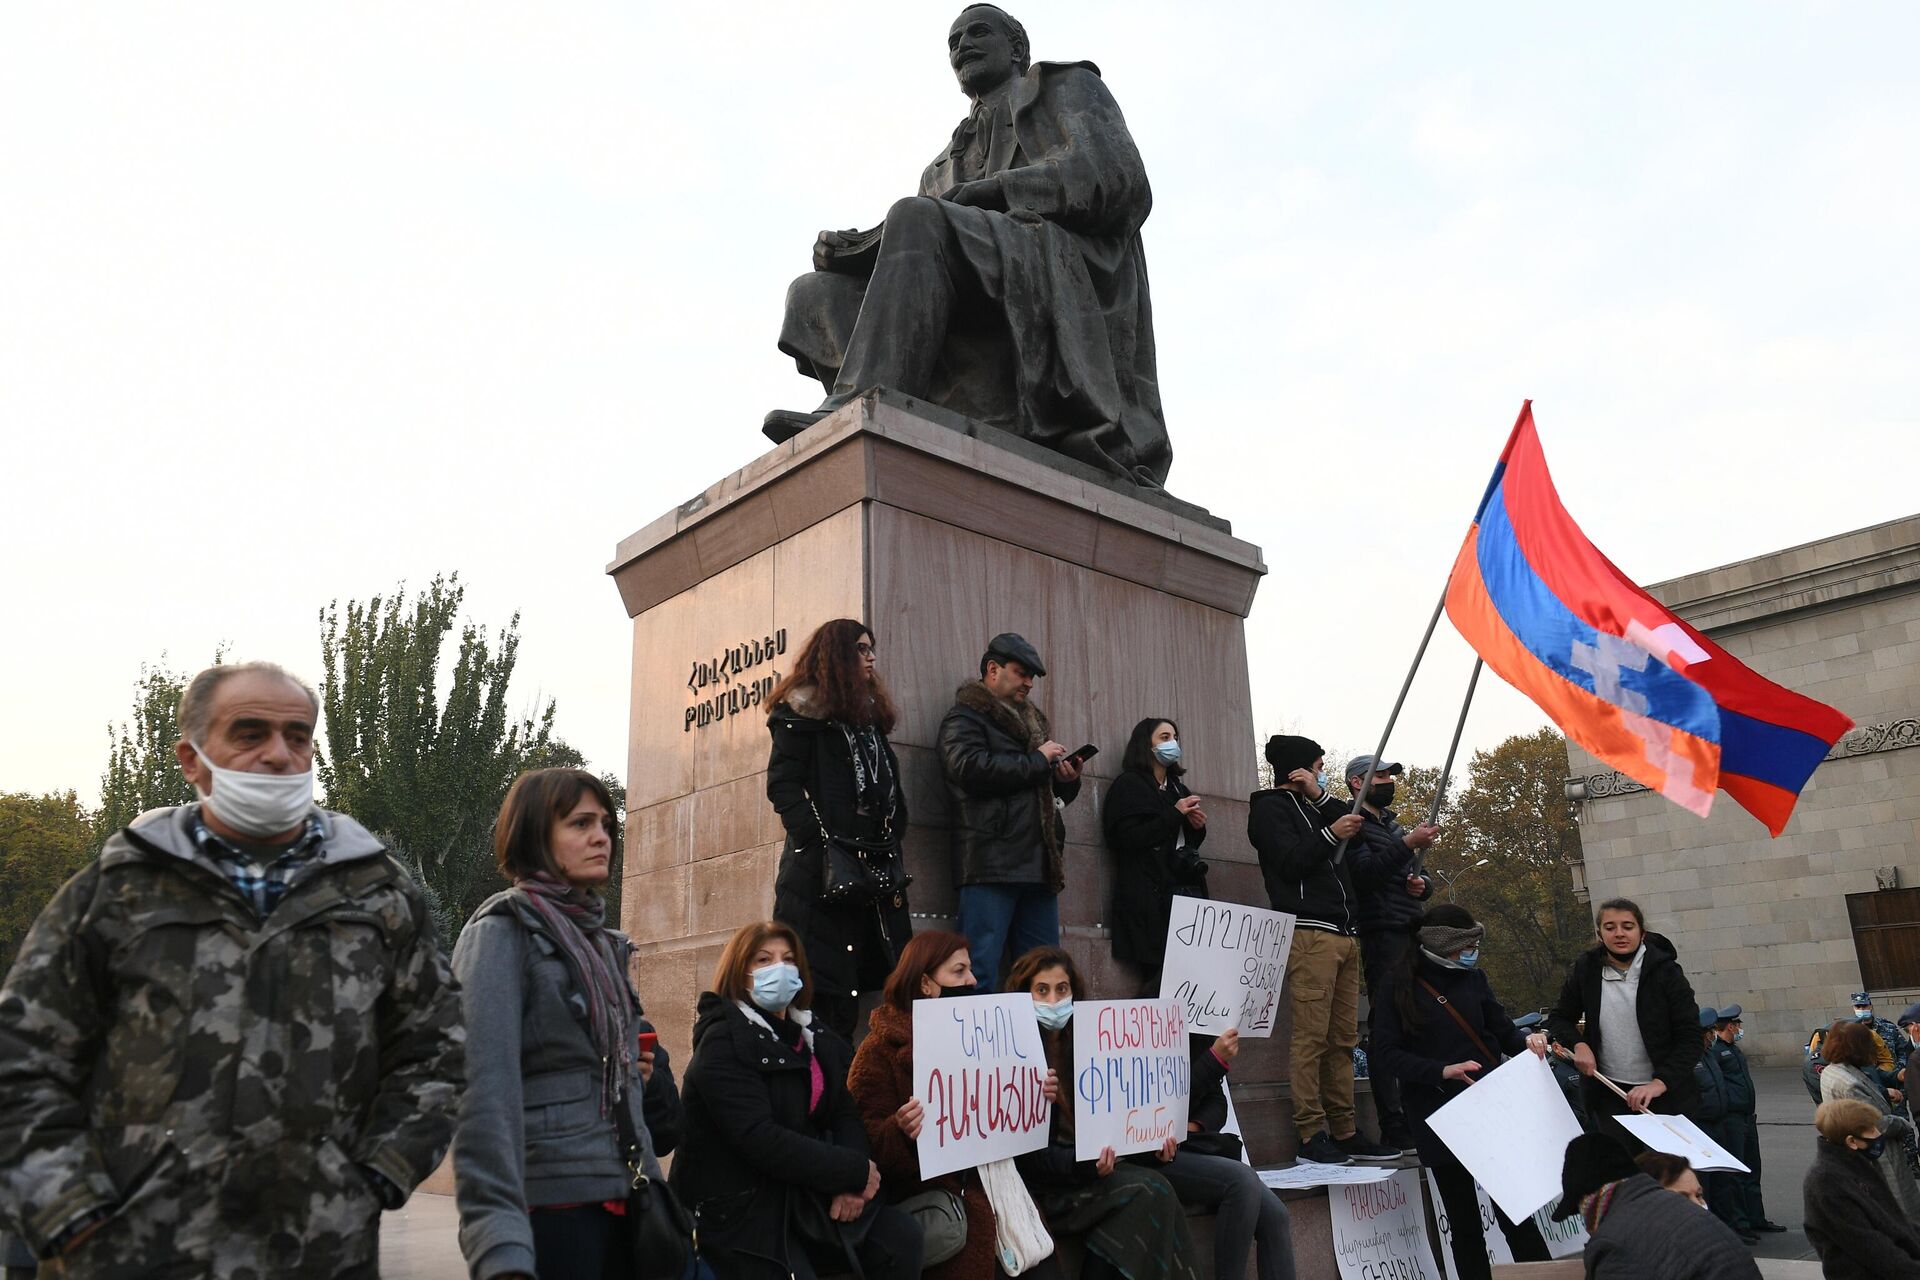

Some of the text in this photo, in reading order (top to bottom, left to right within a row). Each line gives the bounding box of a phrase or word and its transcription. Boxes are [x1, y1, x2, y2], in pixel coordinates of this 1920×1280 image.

[687, 628, 787, 697] ՀՈՎՀԱՆՆԵՍ
[1175, 904, 1288, 960] ԺՈՂՈՎՐԴԻ
[953, 1005, 1027, 1062] ՆԻԿՈԼ
[928, 1065, 1048, 1148] ԴԱՎԱՃԱՆ
[1079, 1056, 1190, 1115] ՓՐԿՈՒԹՅԱՆ
